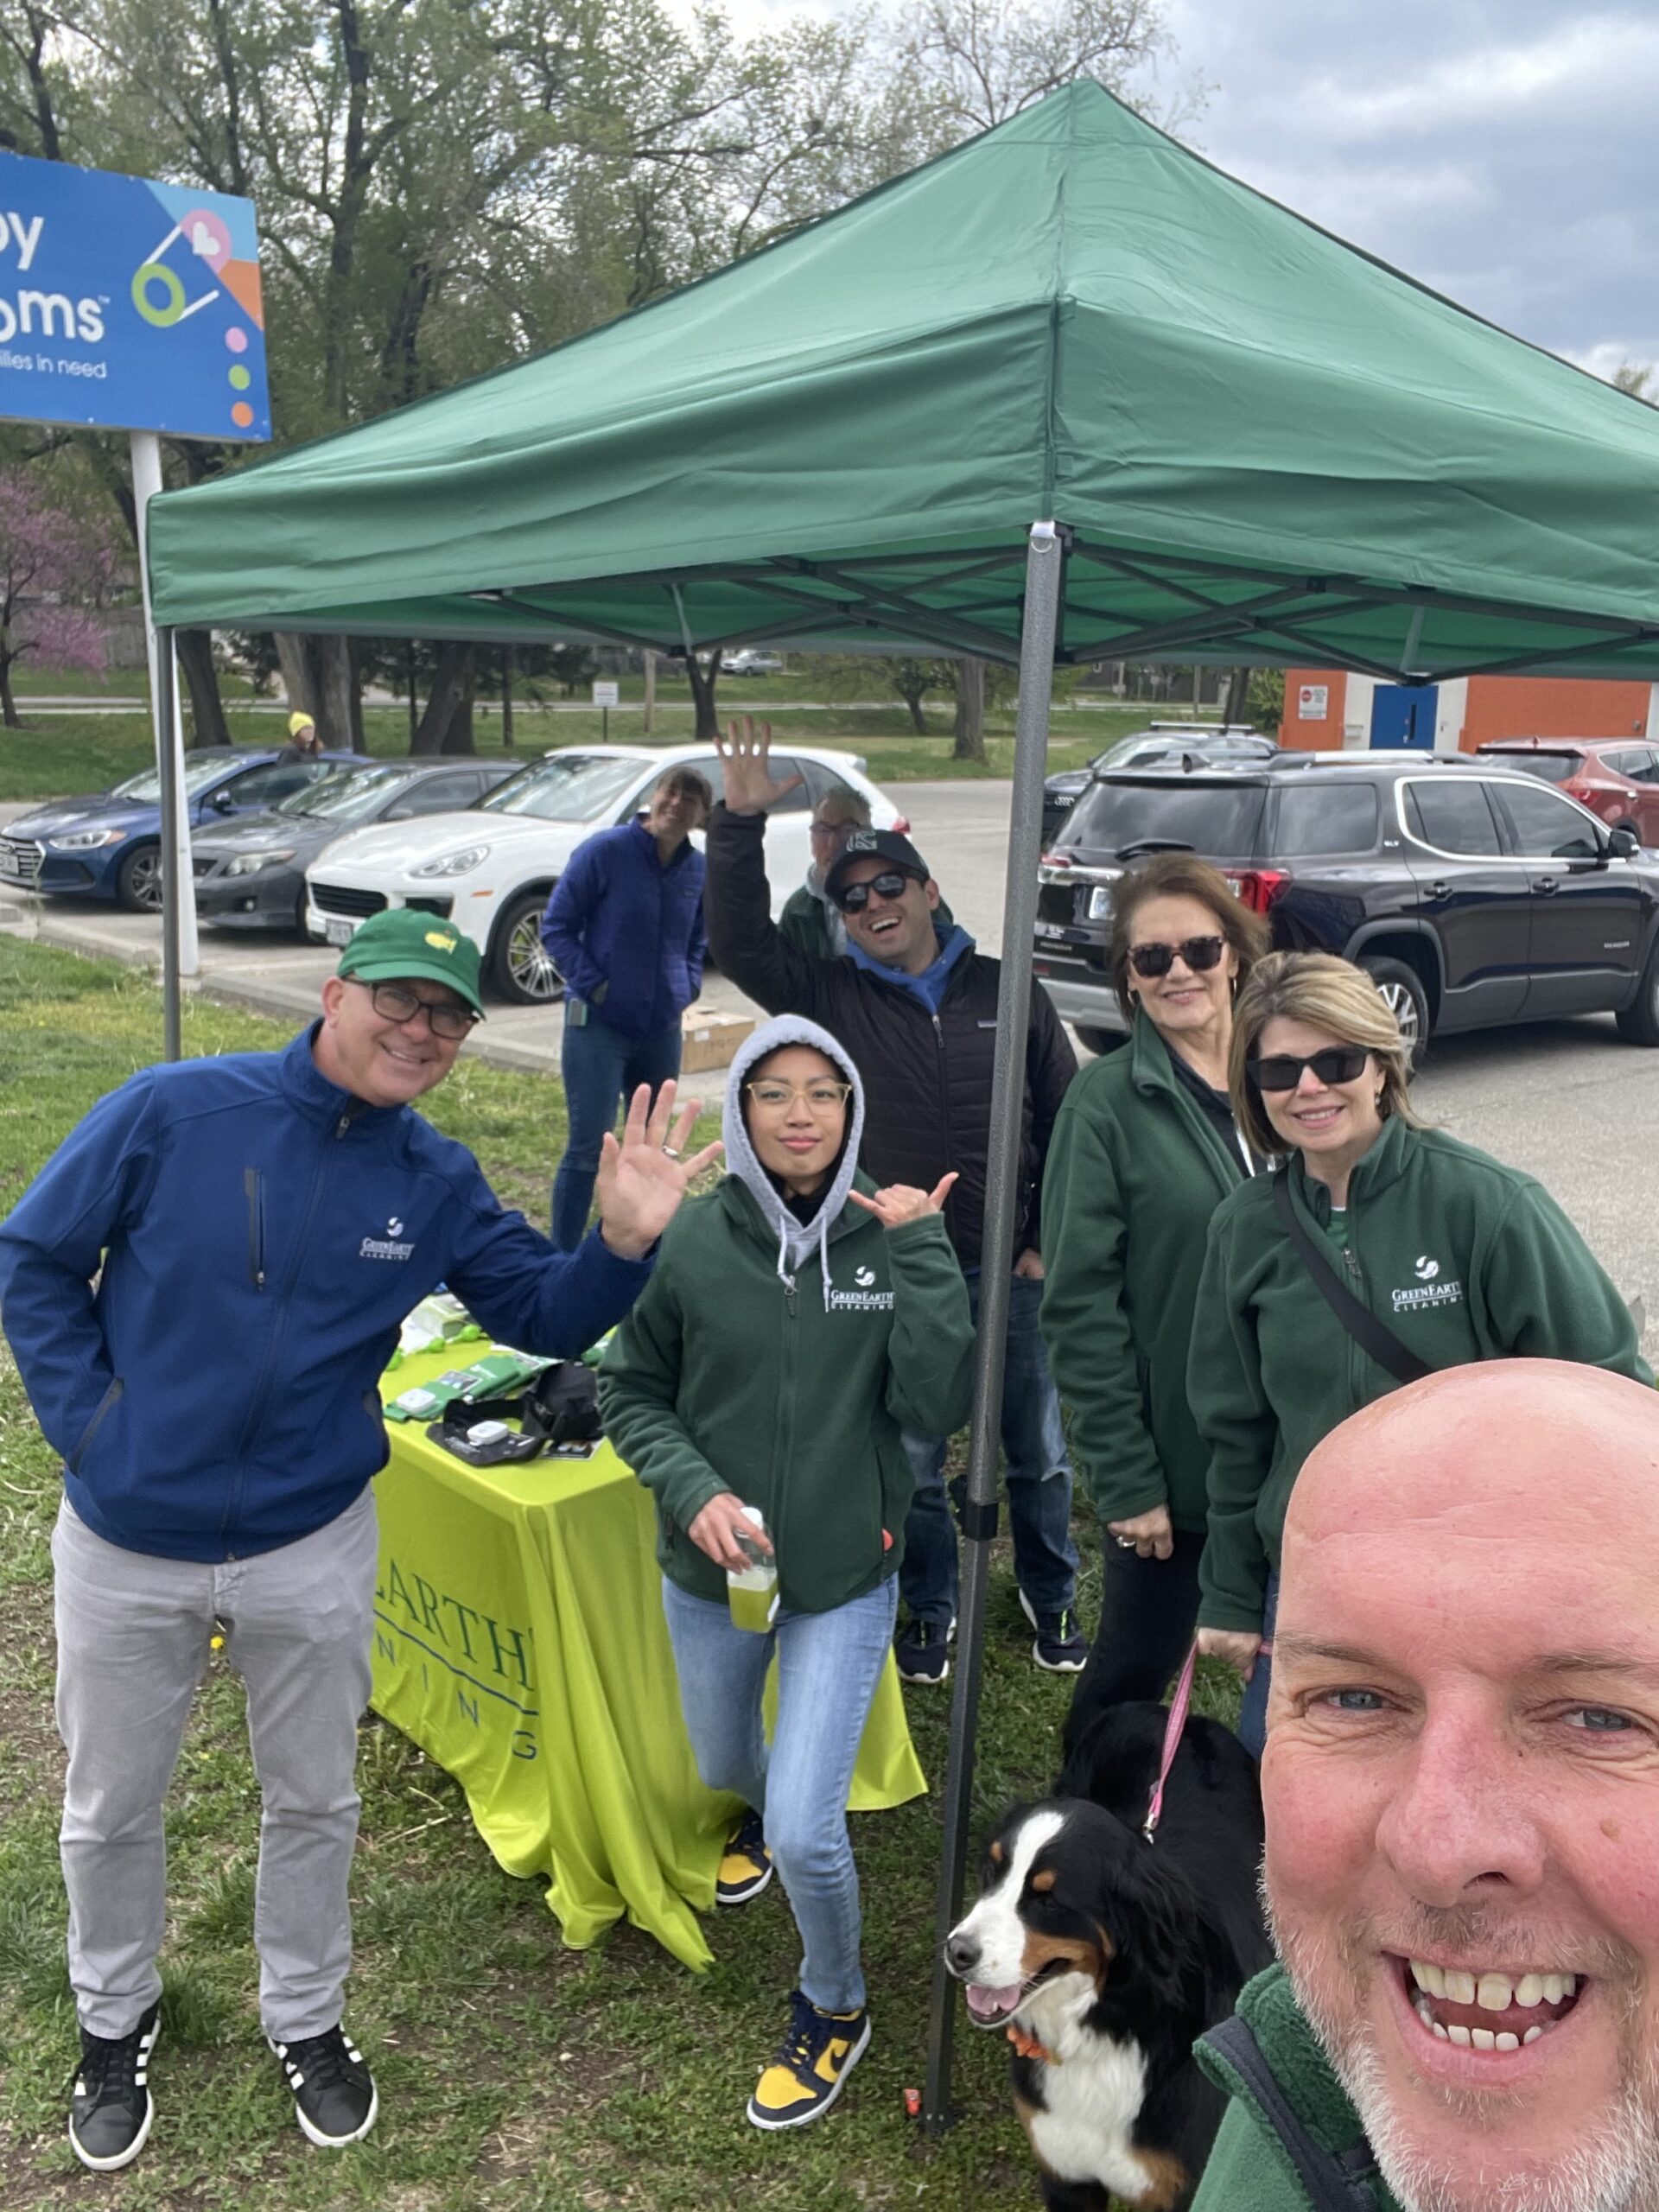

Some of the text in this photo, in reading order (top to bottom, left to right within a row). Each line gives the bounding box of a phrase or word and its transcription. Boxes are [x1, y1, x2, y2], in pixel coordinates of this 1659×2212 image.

[36, 353, 54, 372] in
[57, 359, 107, 378] need
[1394, 1295, 1463, 1312] CLEANIN
[376, 1558, 535, 1691] ARTH
